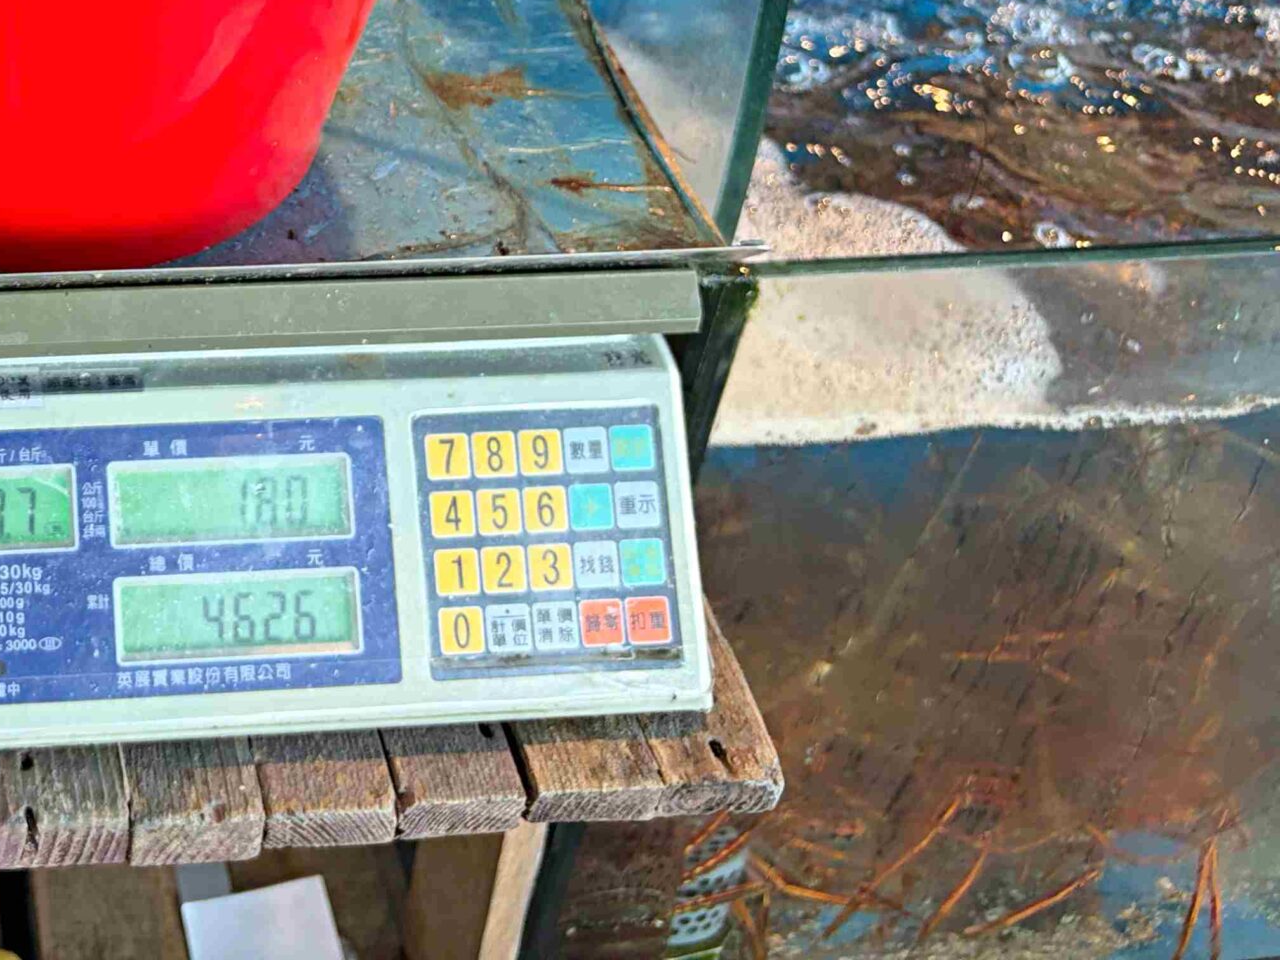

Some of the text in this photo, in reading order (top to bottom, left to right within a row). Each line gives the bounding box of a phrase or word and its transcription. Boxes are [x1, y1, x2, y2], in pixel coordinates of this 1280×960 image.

[143, 434, 315, 456] 單價 元
[439, 439, 455, 474] 7
[487, 436, 503, 472] 8
[532, 435, 549, 469] 9
[570, 440, 603, 460] 數量
[445, 496, 462, 531] 4
[491, 494, 508, 529] 5
[537, 492, 555, 527] 6
[149, 548, 324, 572] 總價 元
[451, 554, 465, 589] 1
[496, 552, 513, 587] 2
[542, 549, 560, 585] 3
[201, 589, 318, 644] 4626
[454, 613, 471, 649] 0
